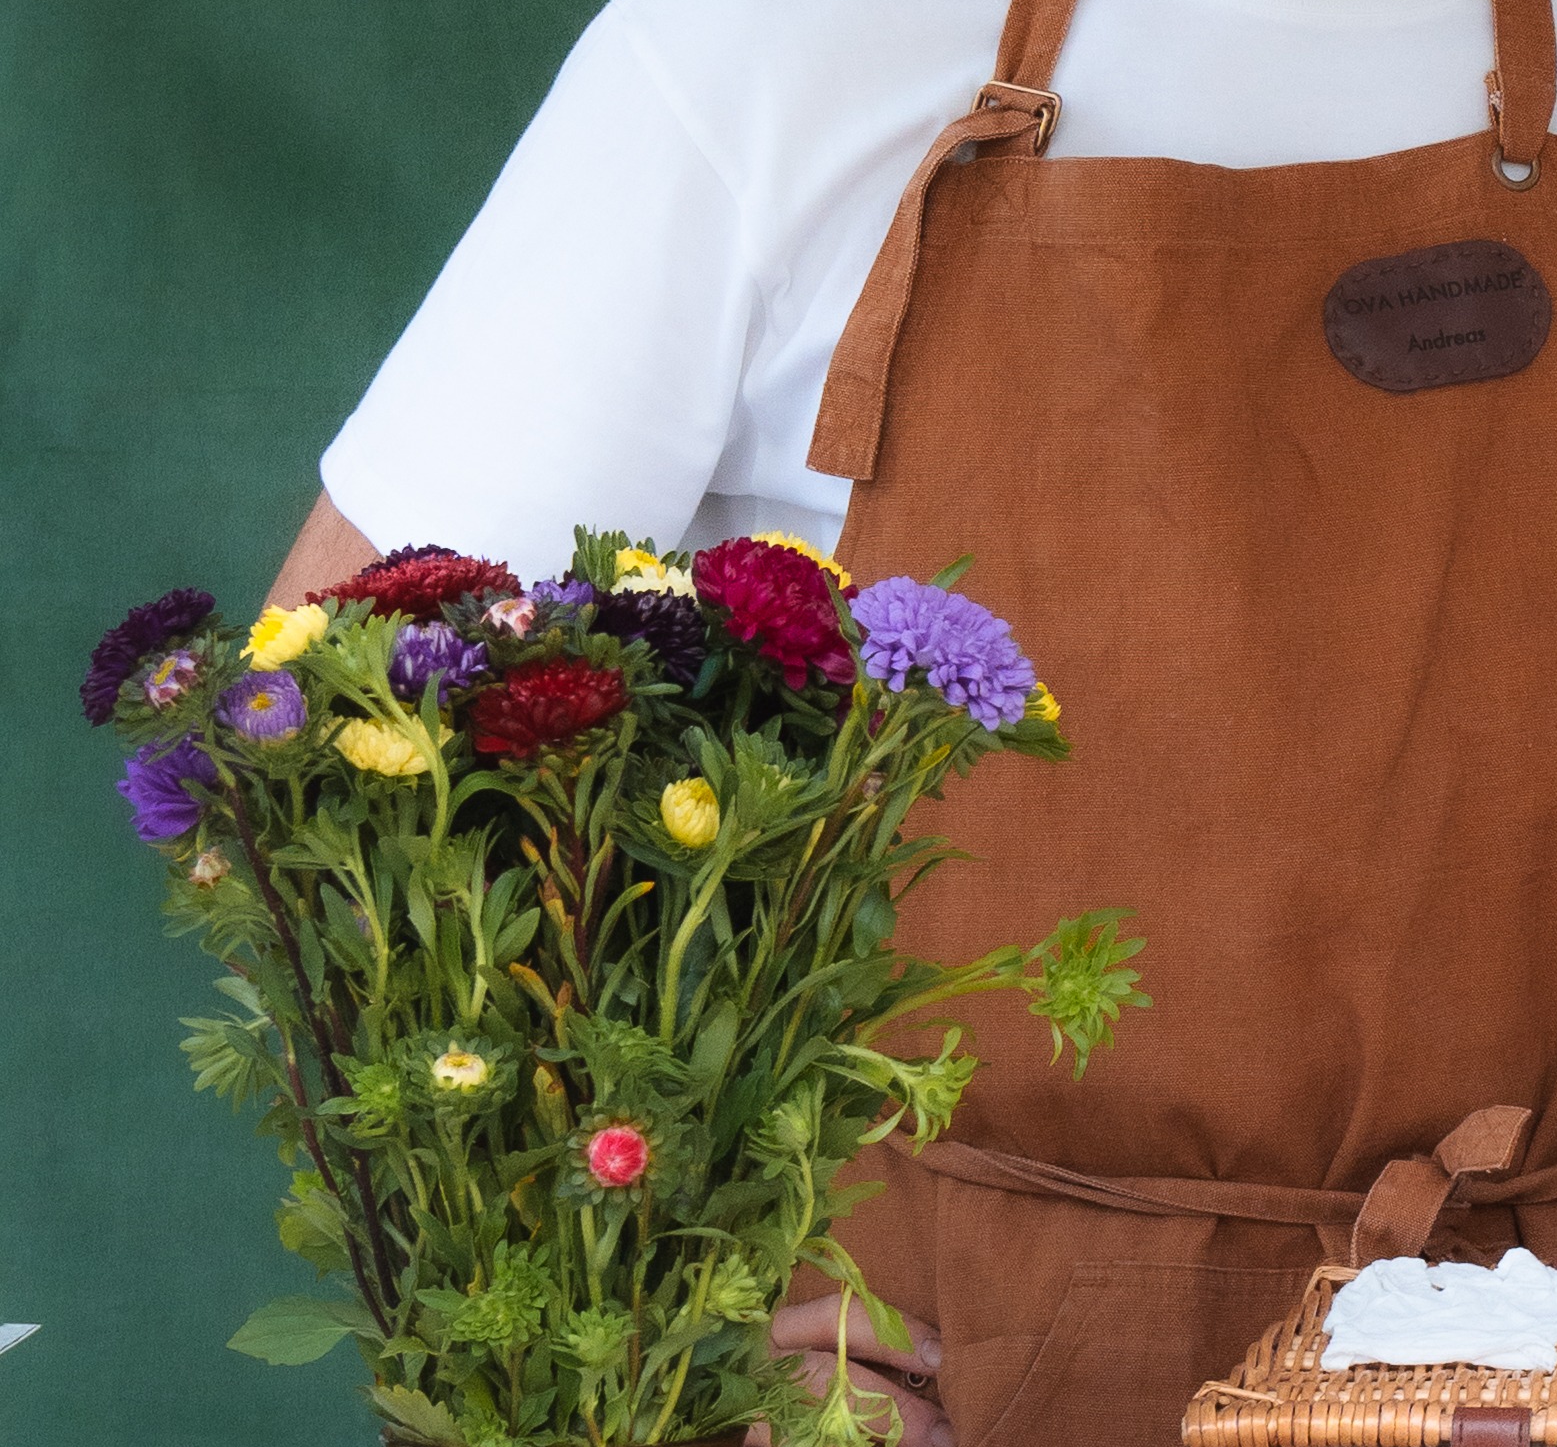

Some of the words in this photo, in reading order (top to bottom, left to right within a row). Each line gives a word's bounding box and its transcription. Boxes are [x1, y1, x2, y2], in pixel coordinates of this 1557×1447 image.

[1343, 295, 1394, 316] OVA
[1398, 270, 1524, 310] HANDMADE
[1407, 328, 1487, 353] Andreas
